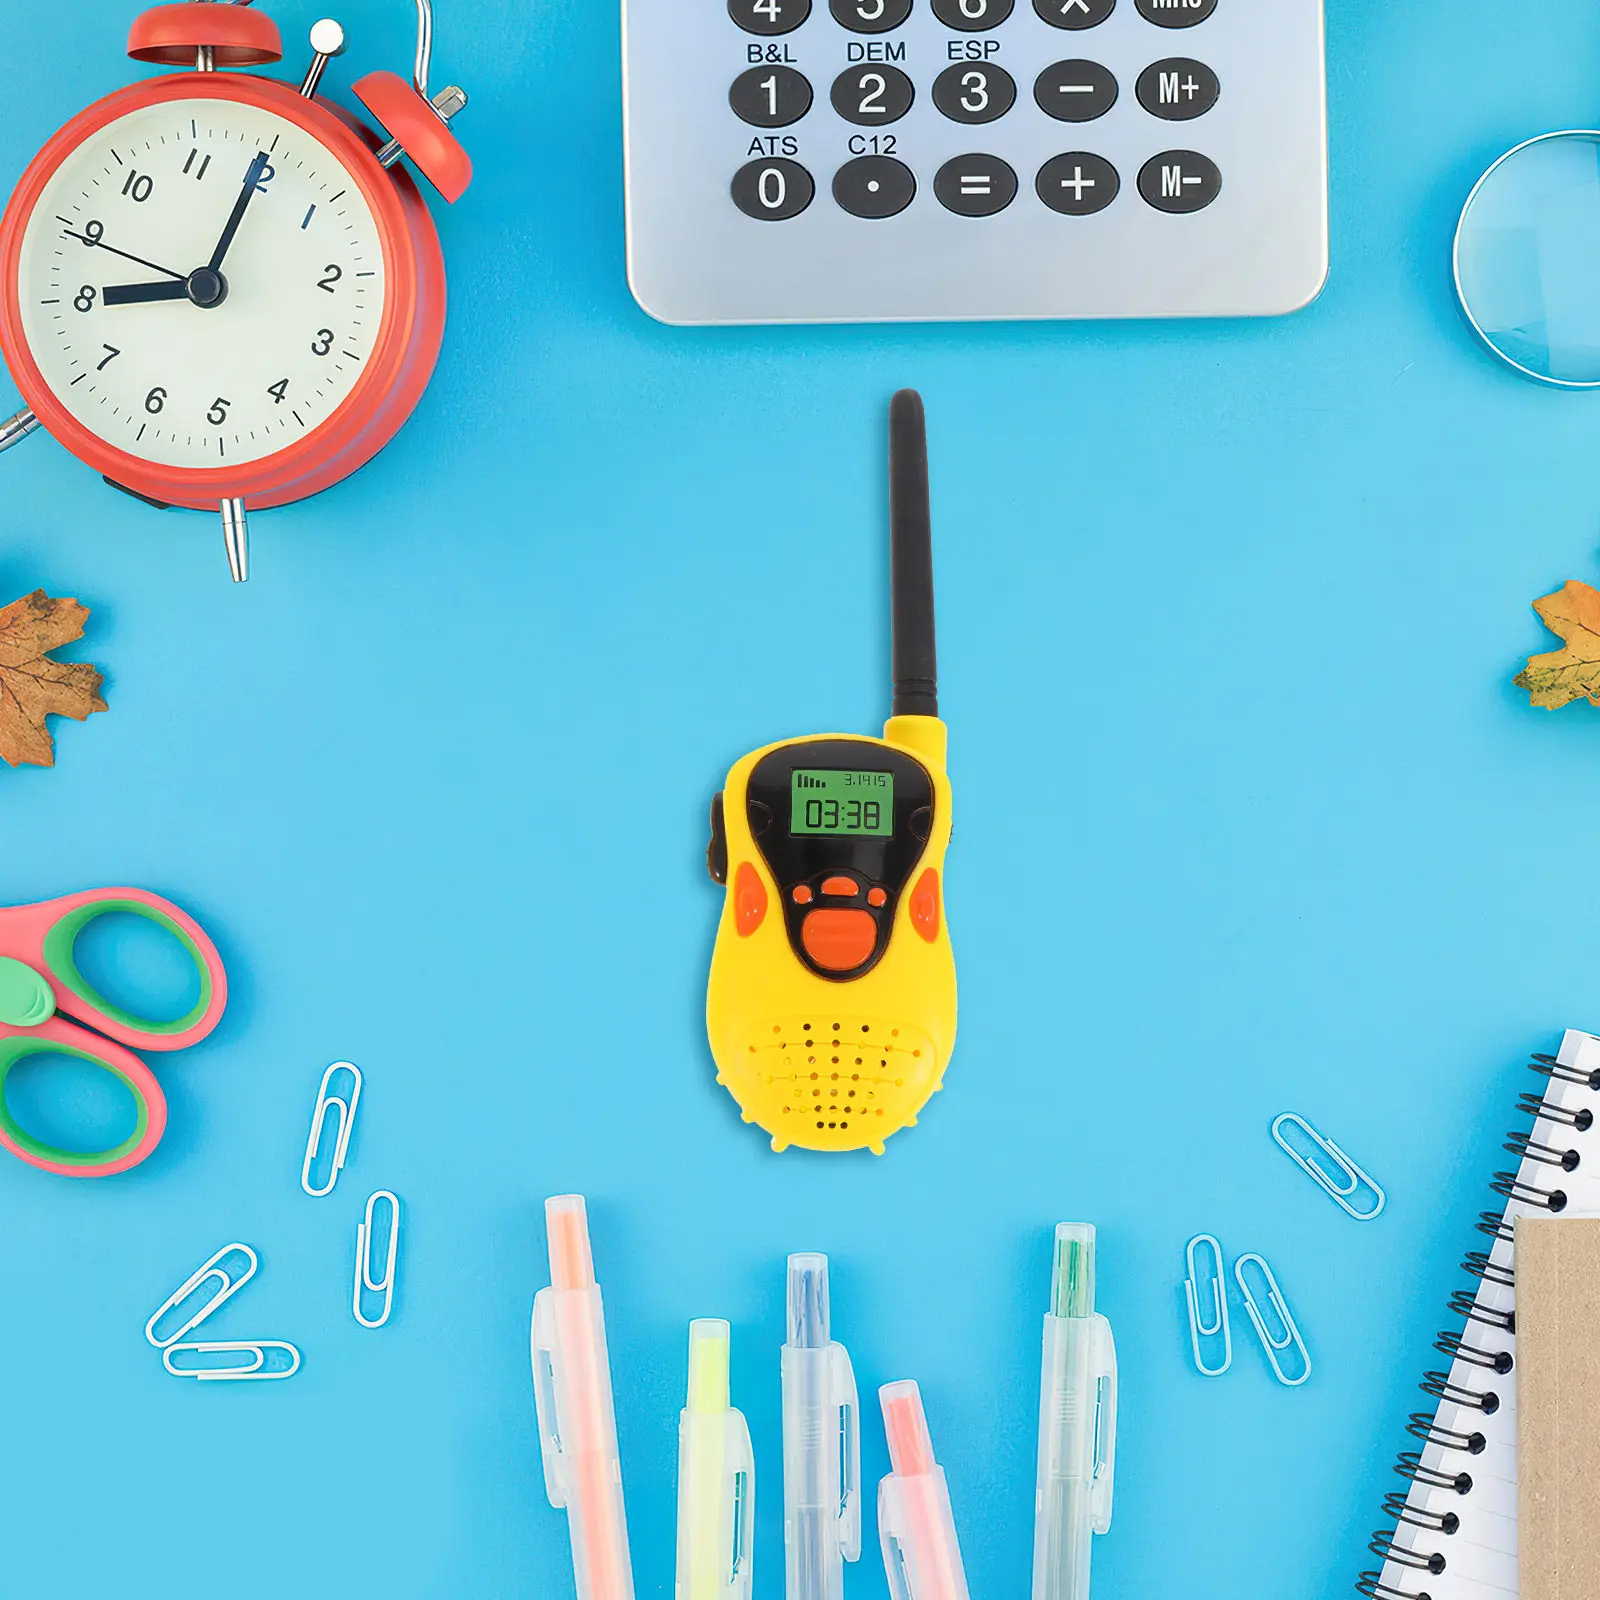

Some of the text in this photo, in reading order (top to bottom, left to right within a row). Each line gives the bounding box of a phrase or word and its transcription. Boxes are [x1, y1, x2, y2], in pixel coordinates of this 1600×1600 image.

[748, 43, 798, 63] B&L
[847, 41, 906, 62] DEM
[947, 40, 1001, 61] ESP
[760, 75, 778, 115] 1
[859, 73, 887, 113] 2
[960, 71, 989, 112] 3
[1159, 72, 1200, 104] M+
[747, 136, 799, 156] ATS
[848, 135, 897, 156] C12
[182, 147, 212, 181] 11
[121, 169, 154, 203] 10
[758, 168, 787, 209] 0
[1160, 165, 1202, 197] M-
[300, 203, 317, 230] 1
[83, 219, 105, 247] 9
[316, 263, 343, 294] 2
[73, 284, 97, 313] 8
[96, 343, 121, 371] 7
[311, 328, 335, 357] 3
[144, 386, 168, 415] 6
[266, 378, 290, 405] 4
[206, 397, 231, 426] 5
[844, 773, 886, 787] 3.1415
[805, 799, 881, 830] 03:38
